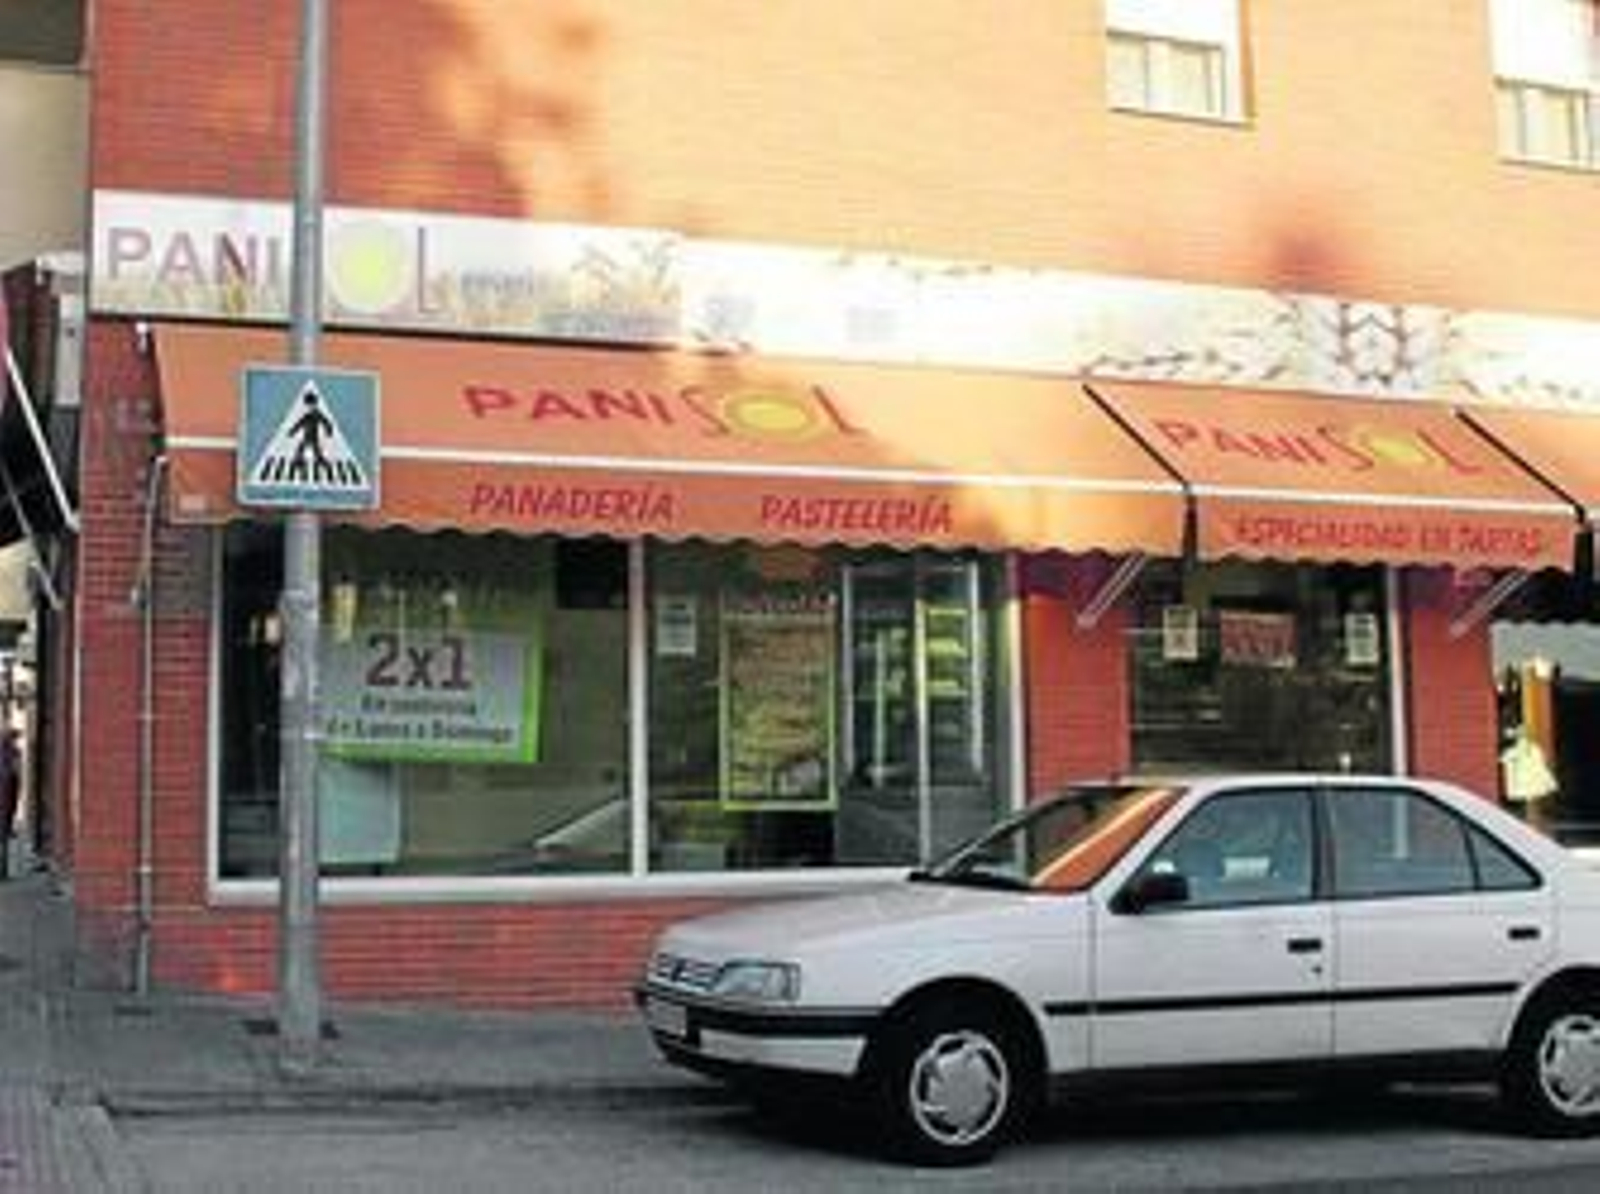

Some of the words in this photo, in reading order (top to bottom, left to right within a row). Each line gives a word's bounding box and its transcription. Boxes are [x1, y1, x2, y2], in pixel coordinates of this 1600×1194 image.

[471, 481, 674, 526] PANADERÍA
[761, 493, 953, 535] PASTELERÍA
[366, 632, 472, 690] 2x1
